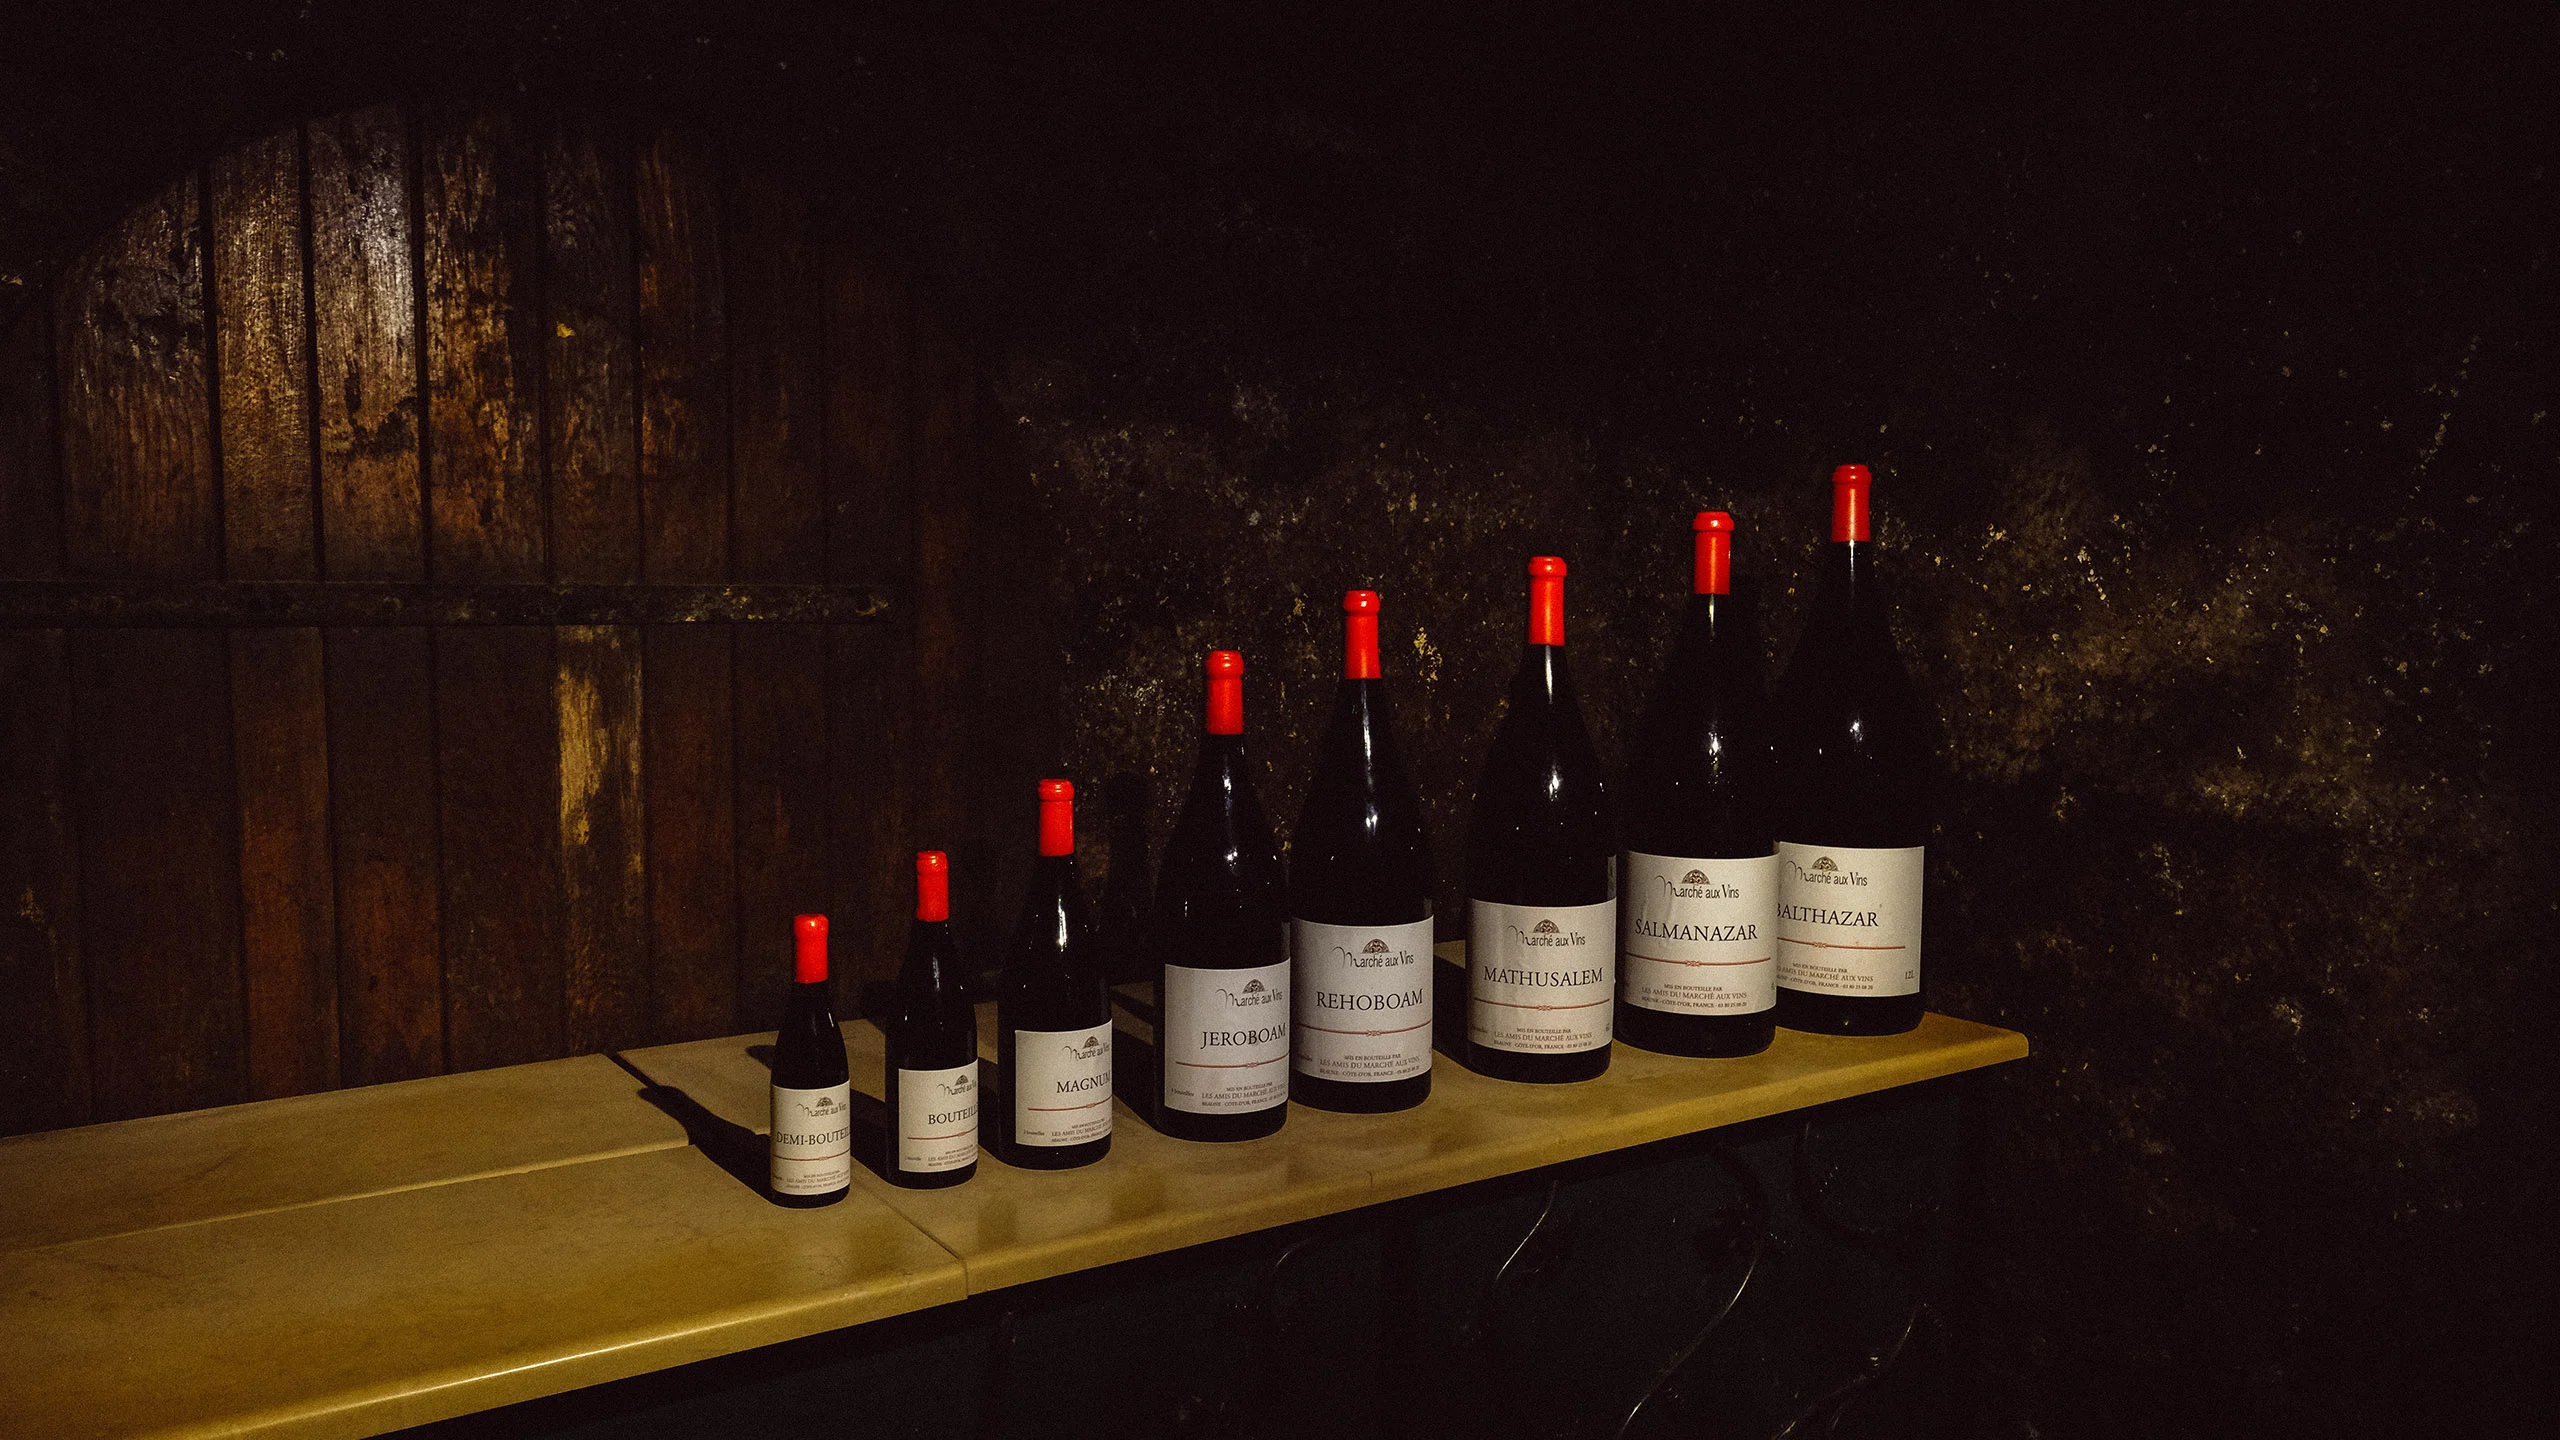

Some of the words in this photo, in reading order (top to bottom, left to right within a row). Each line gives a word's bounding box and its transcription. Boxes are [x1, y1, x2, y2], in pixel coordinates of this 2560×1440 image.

[1785, 860, 1831, 885] Marché
[1834, 875, 1849, 886] aux
[1849, 872, 1868, 887] Vins
[1655, 875, 1702, 899] Marché
[1705, 888, 1720, 899] aux
[1722, 884, 1740, 899] Vins
[1508, 925, 1553, 946] Marché
[1556, 936, 1569, 946] aux
[1570, 932, 1586, 946] Vins
[1635, 918, 1758, 942] SALMANAZAR
[1332, 946, 1383, 968] Marché
[1384, 956, 1398, 967] aux
[1400, 950, 1414, 965] Vins
[1484, 966, 1603, 987] MATHUSALEM
[1215, 988, 1260, 1008] Marché
[1261, 994, 1273, 1005] aux
[1316, 988, 1423, 1011] REHOBOAM
[1682, 991, 1714, 1000] MARCHÉ
[1731, 991, 1747, 999] VINS
[1200, 1022, 1286, 1049] JEROBOAM
[1062, 1045, 1096, 1061] Marché
